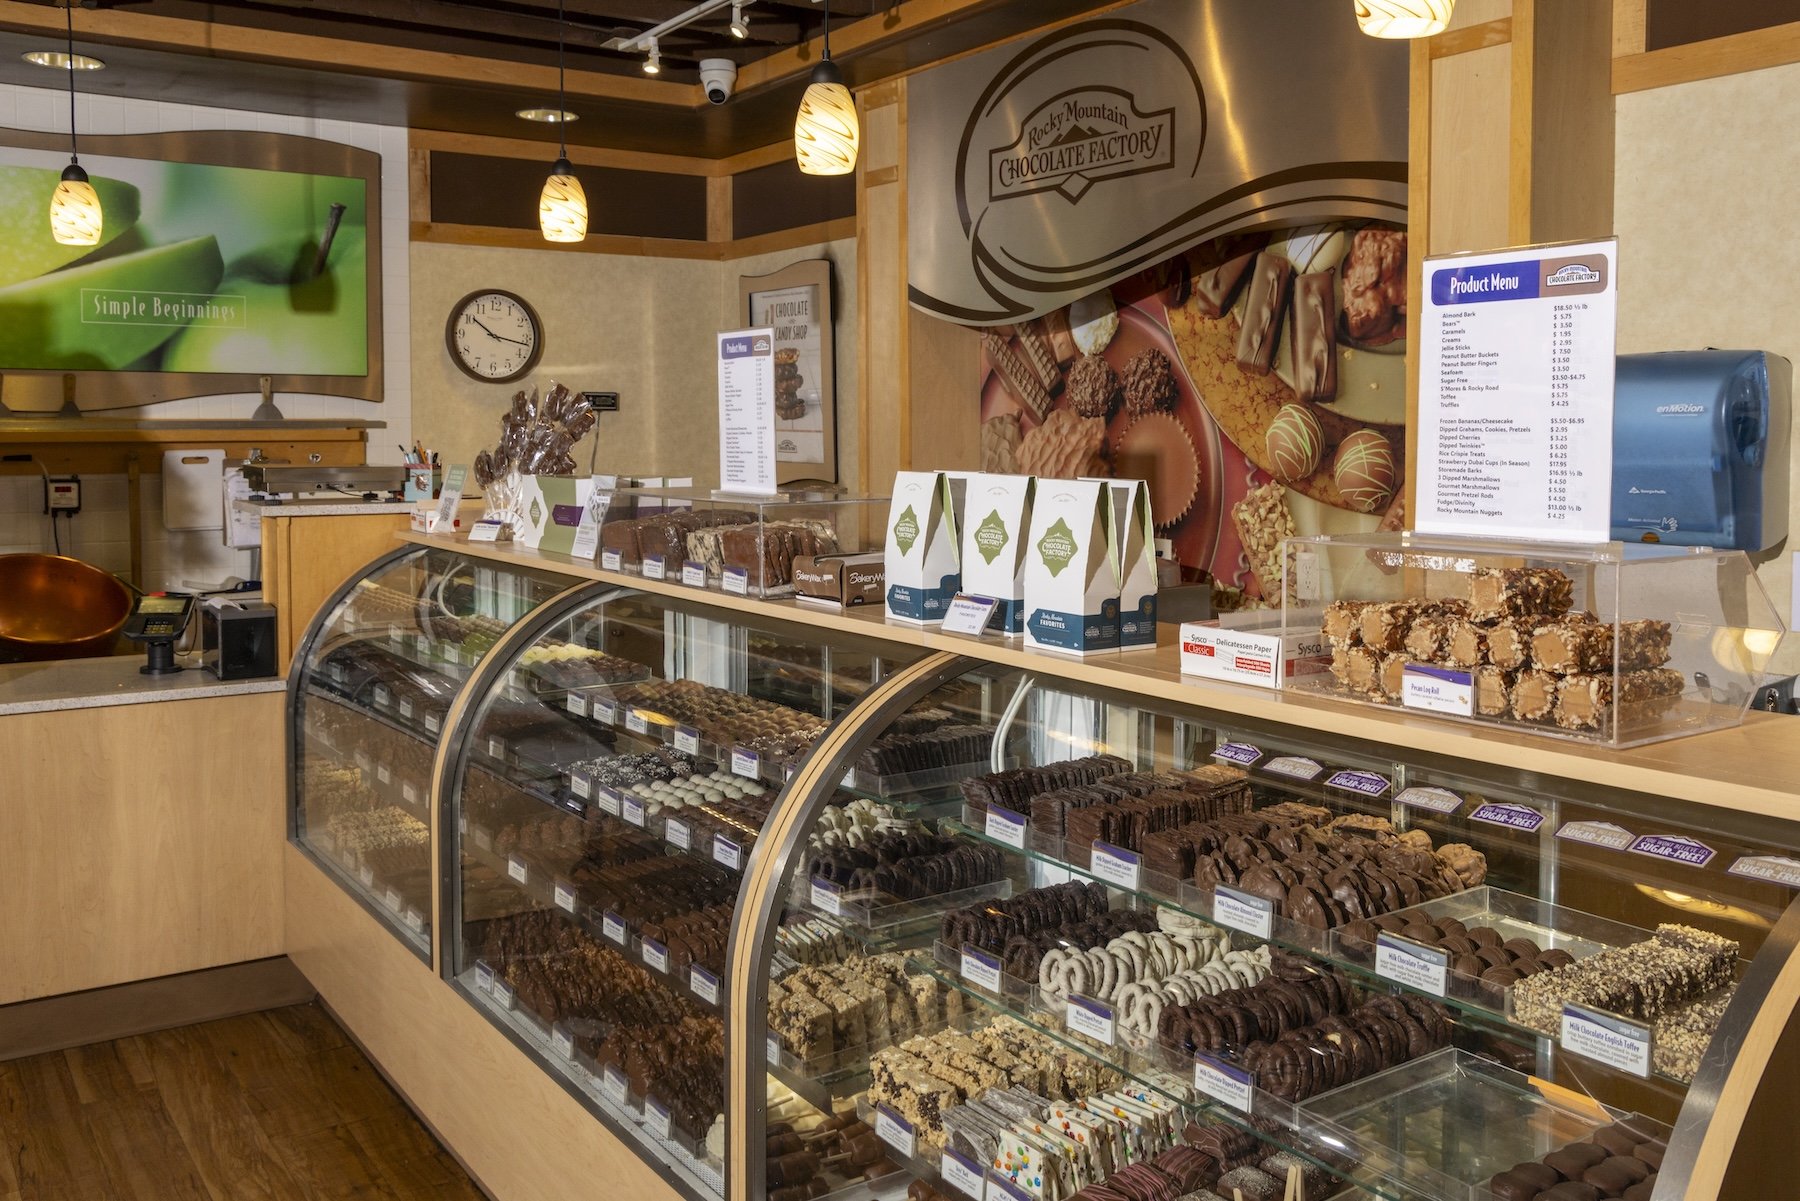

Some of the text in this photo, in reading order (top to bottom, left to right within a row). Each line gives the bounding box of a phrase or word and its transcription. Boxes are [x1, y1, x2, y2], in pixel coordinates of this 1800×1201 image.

[1027, 100, 1129, 150] Rocky Mountain
[999, 124, 1164, 188] CHOCOLATE FACTORY
[1450, 272, 1519, 294] Product Menu
[1549, 272, 1597, 284] CHOCOLATE FACTORY
[94, 294, 236, 322] Simple Beginnings
[476, 304, 485, 314] 11
[491, 300, 501, 311] 12
[776, 300, 808, 318] CHOCOLATE
[465, 314, 475, 324] 10
[517, 318, 523, 327] 2
[458, 329, 465, 338] 9
[776, 325, 807, 341] CANDY SHOP
[463, 345, 470, 356] 8
[516, 348, 522, 358] 4
[475, 357, 482, 368] 7
[490, 362, 496, 372] 6
[505, 359, 511, 368] 5
[1656, 404, 1704, 413] enMotion
[896, 526, 916, 535] CHOCOLATE
[978, 532, 1003, 544] CHOCOLATE
[981, 538, 1000, 546] FACTORY
[1042, 542, 1072, 554] CHOCOLATE
[1040, 620, 1065, 629] FAVORITES
[1191, 634, 1272, 654] Sysco Delicatessen Paper
[1298, 643, 1322, 656] Sysco
[1188, 645, 1210, 656] Classic
[1411, 683, 1422, 692] Pecan
[1332, 776, 1381, 793] SUGAR-FREE!
[1402, 793, 1452, 809] SUGAR-FREE!
[1476, 810, 1536, 828] SUGAR-FREE!
[1563, 827, 1627, 847] SUGAR-FREE!
[1637, 842, 1704, 862] SUGAR-FREE!
[1398, 955, 1416, 968] Chocolate
[1417, 961, 1430, 972] Truffle
[1570, 1021, 1640, 1052] Milk Chocolate English Toffee
